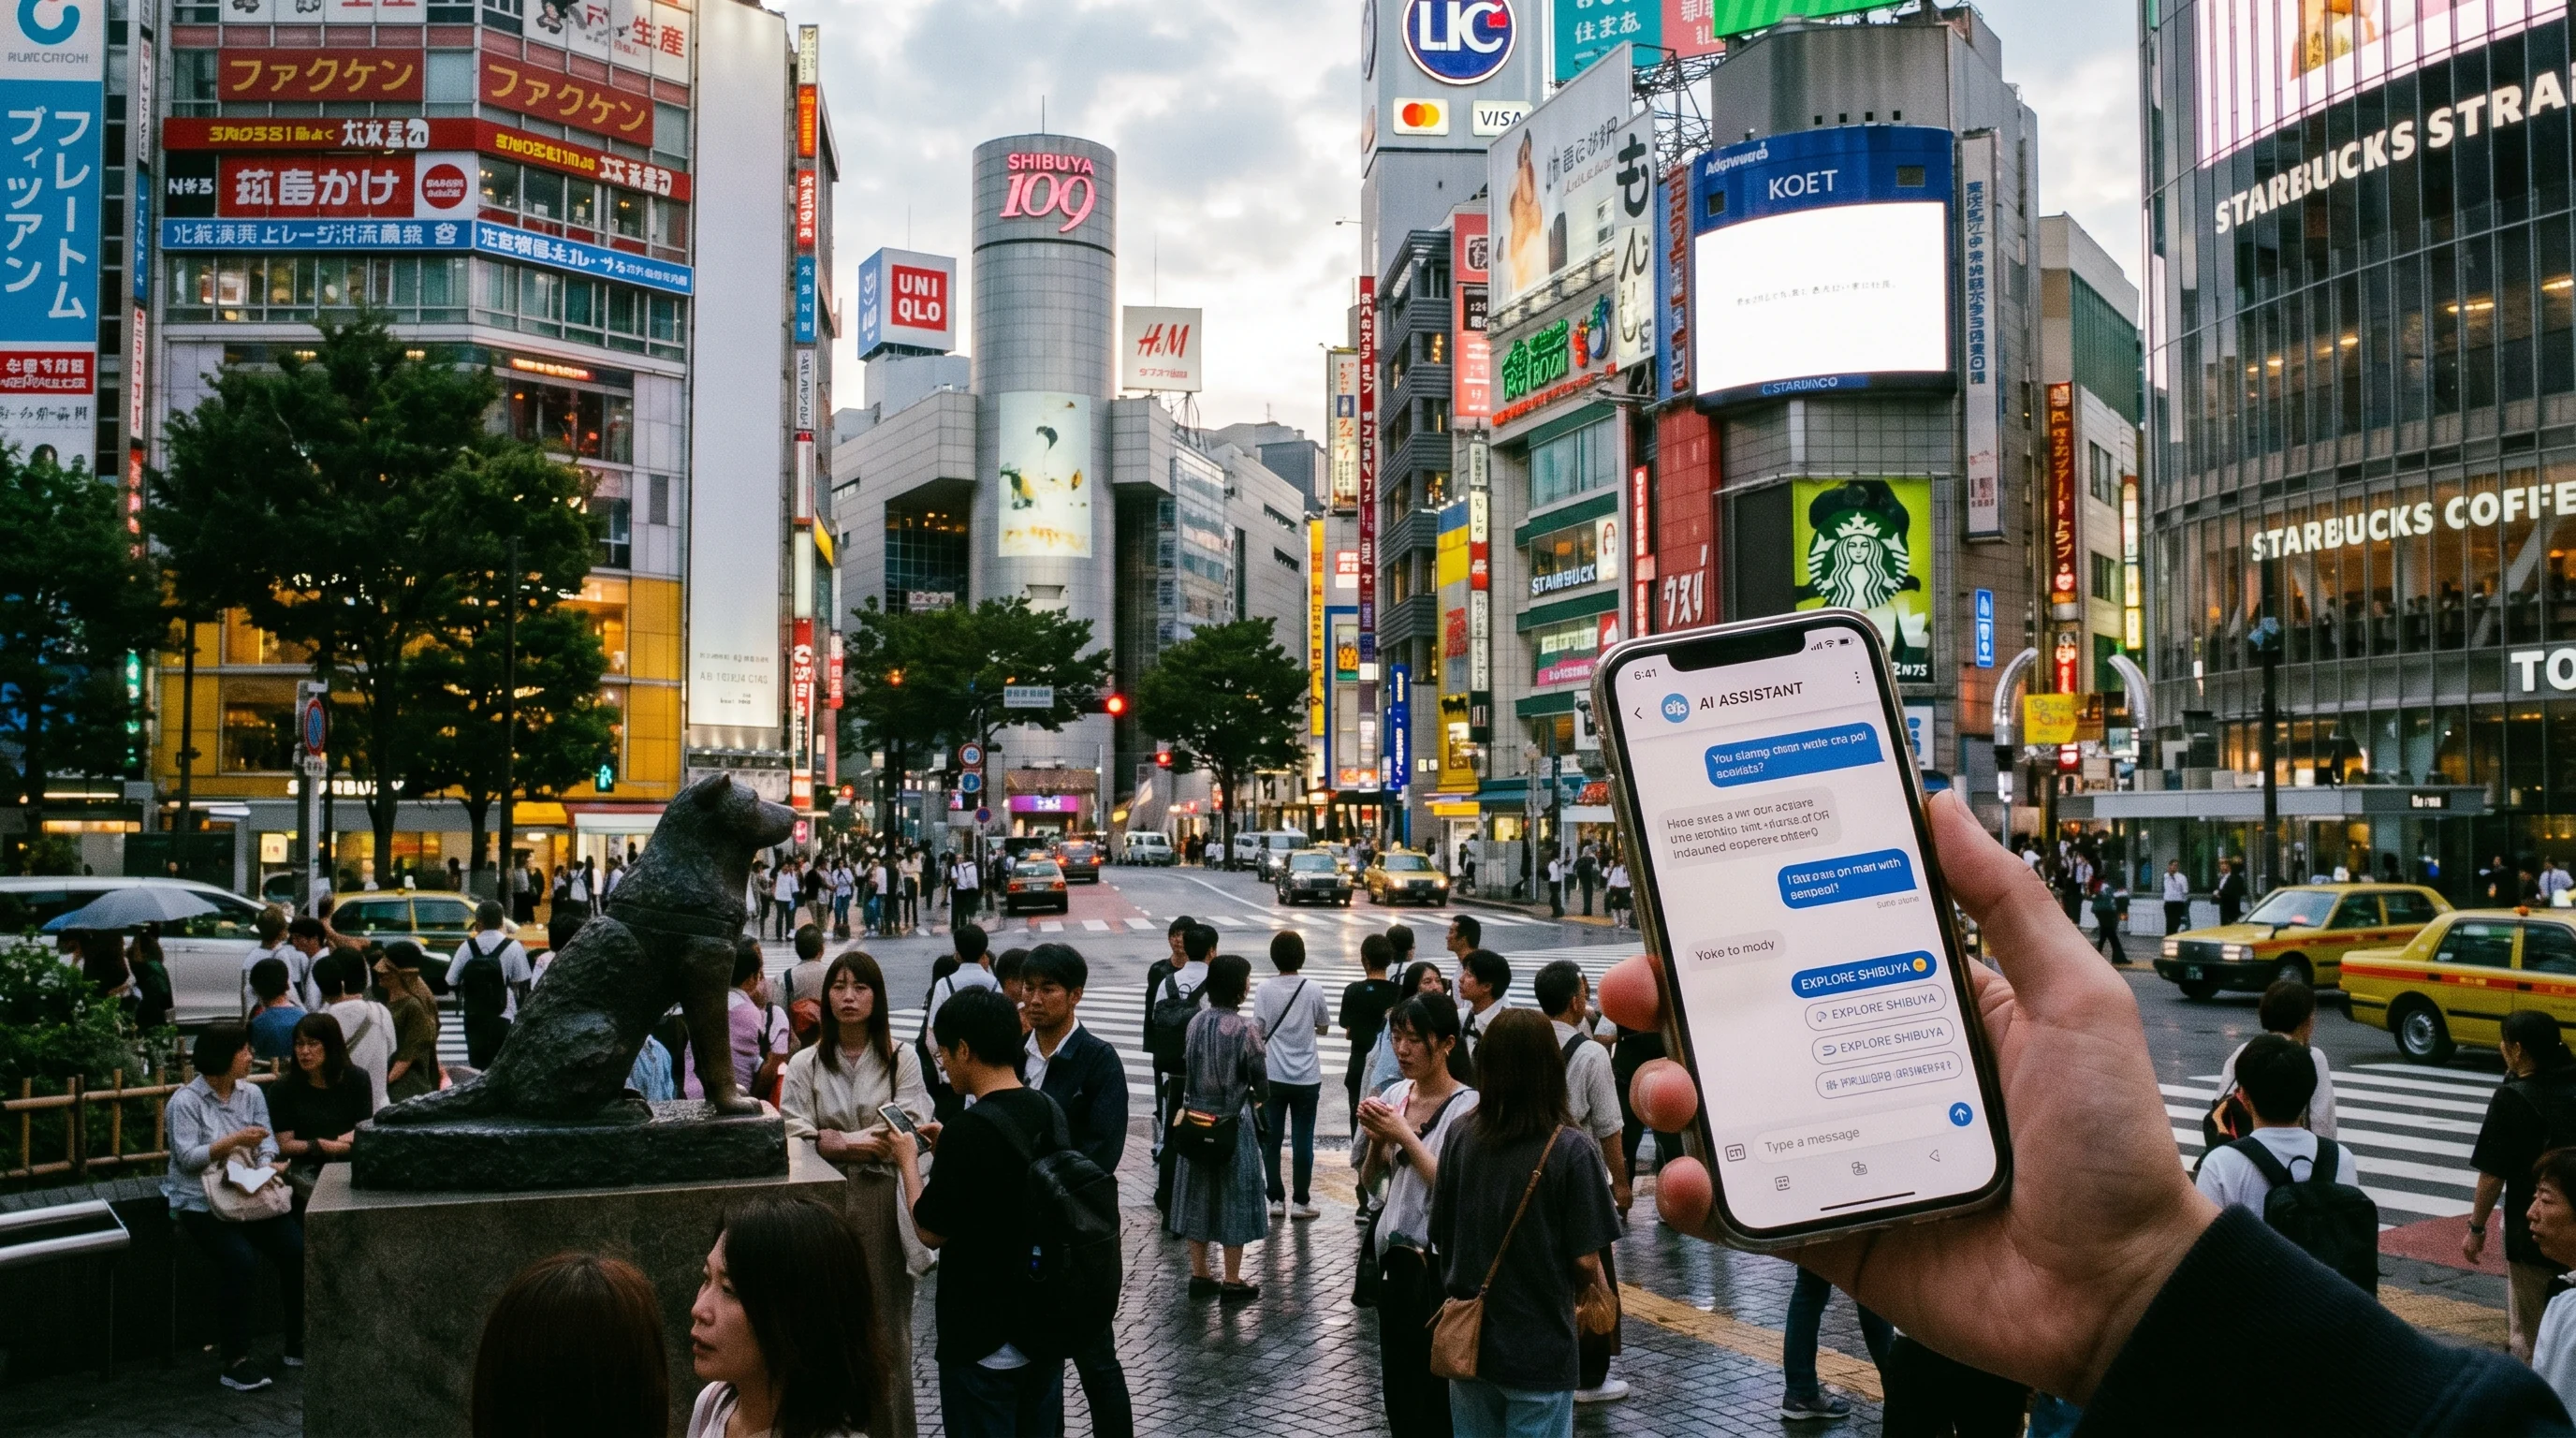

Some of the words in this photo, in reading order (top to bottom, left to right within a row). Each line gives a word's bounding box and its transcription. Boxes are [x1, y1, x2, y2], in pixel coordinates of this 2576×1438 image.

[229, 58, 414, 93] ファクケン
[488, 64, 648, 132] ファクケン
[2215, 120, 2416, 234] STARBUCKS
[2427, 62, 2576, 150] STRA
[1007, 154, 1094, 175] SHIBUYA
[1769, 169, 1838, 200] KOET
[999, 171, 1097, 233] 109
[899, 272, 939, 299] UNI
[898, 296, 942, 323] QLO
[1137, 323, 1190, 359] H&M
[2251, 501, 2434, 562] STARBUCKS
[2444, 480, 2576, 531] COFFE
[1633, 668, 1657, 681] 6:41
[2510, 647, 2576, 693] TO
[1700, 697, 1714, 711] AI
[1719, 682, 1804, 708] ASSISTANT
[1712, 753, 1734, 765] You
[1695, 946, 1725, 961] Yoke
[1727, 945, 1740, 956] to
[1743, 939, 1776, 955] mody
[1801, 971, 1857, 990] EXPLORE
[1858, 962, 1910, 981] SHIBUYA
[1831, 1002, 1885, 1020] EXPLORE
[1885, 992, 1937, 1012] SHIBUYA
[1840, 1034, 1893, 1053] EXPLORE
[1894, 1026, 1944, 1044] SHIBUYA
[1764, 1139, 1794, 1154] Type
[1797, 1137, 1805, 1148] a
[1807, 1128, 1861, 1146] message
